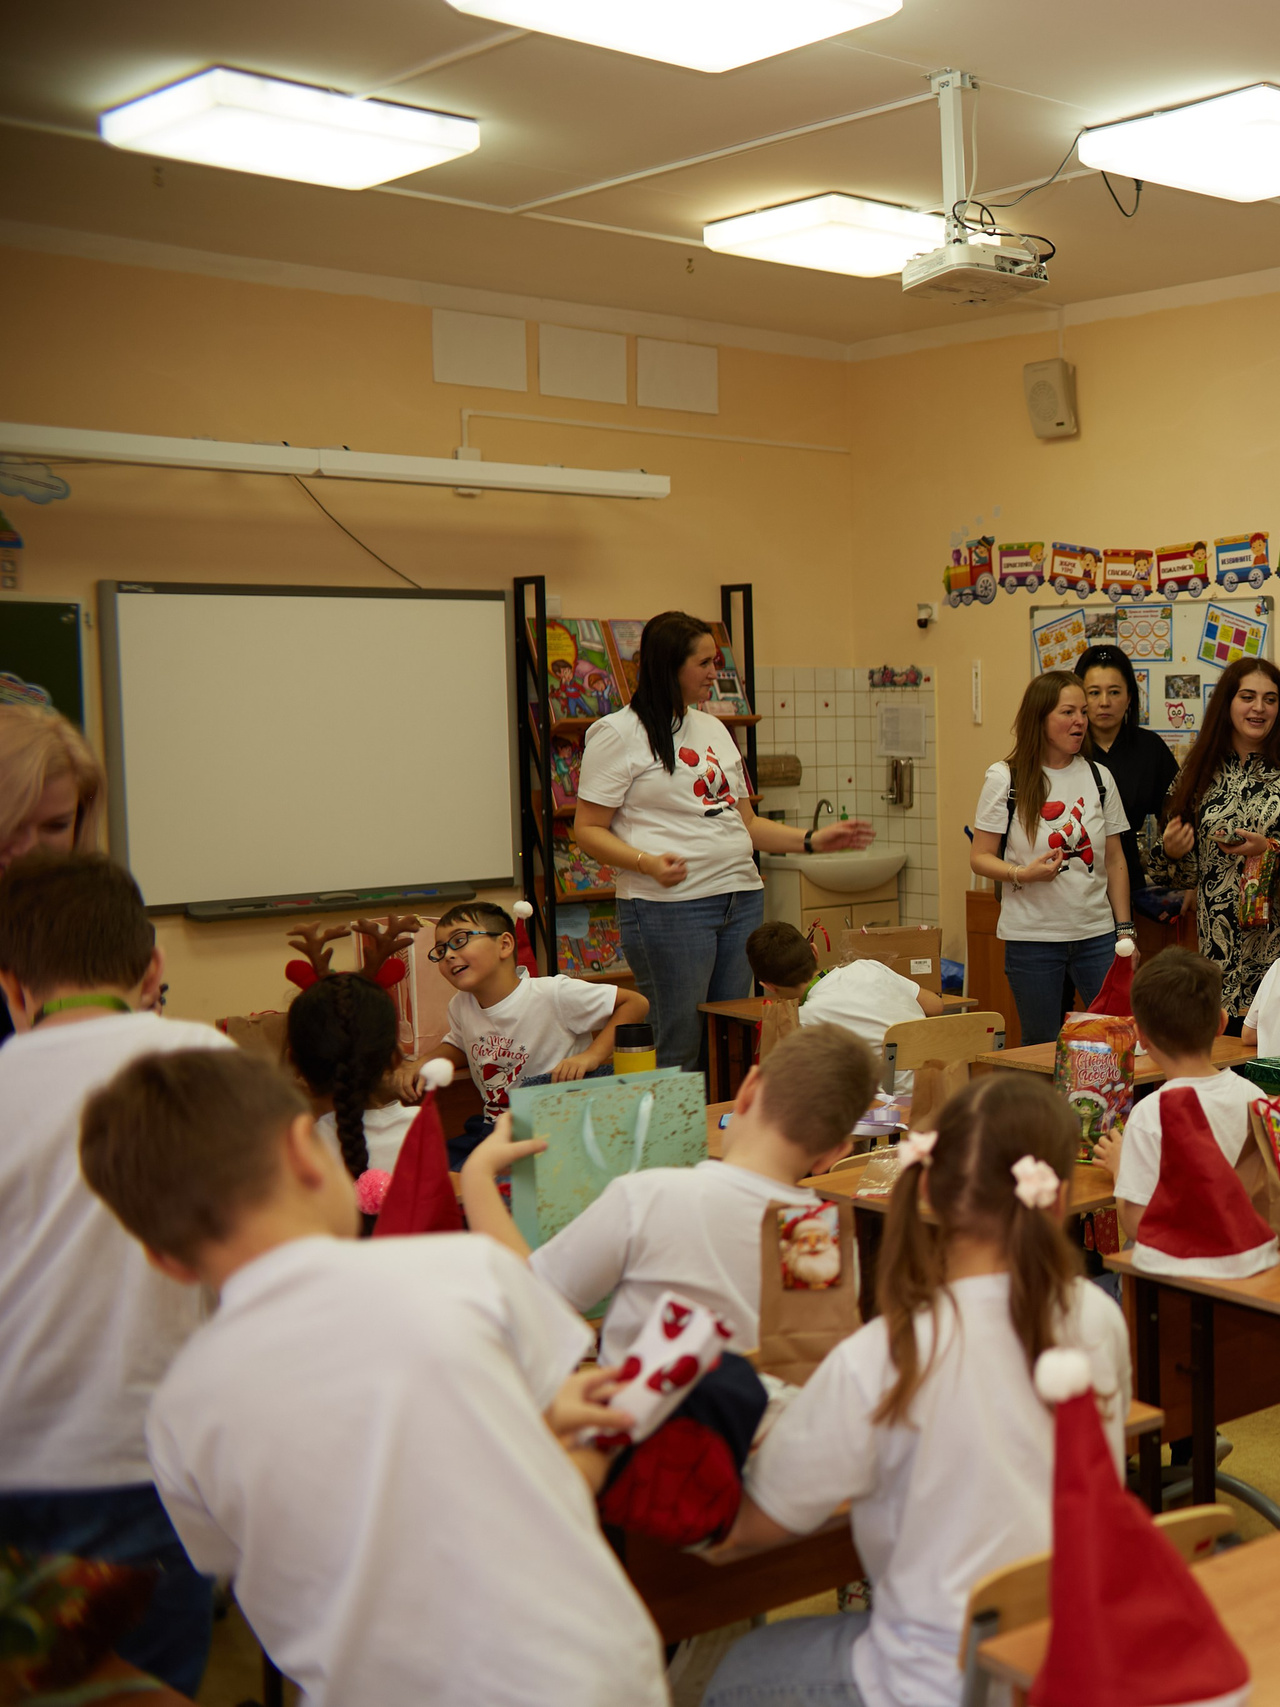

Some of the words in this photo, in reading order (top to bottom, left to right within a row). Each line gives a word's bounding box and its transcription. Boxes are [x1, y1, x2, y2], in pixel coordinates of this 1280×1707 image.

[1220, 554, 1252, 565] ИЗВИНИТЕ
[1107, 568, 1133, 576] СПАСИБО
[471, 1043, 530, 1066] Christmas
